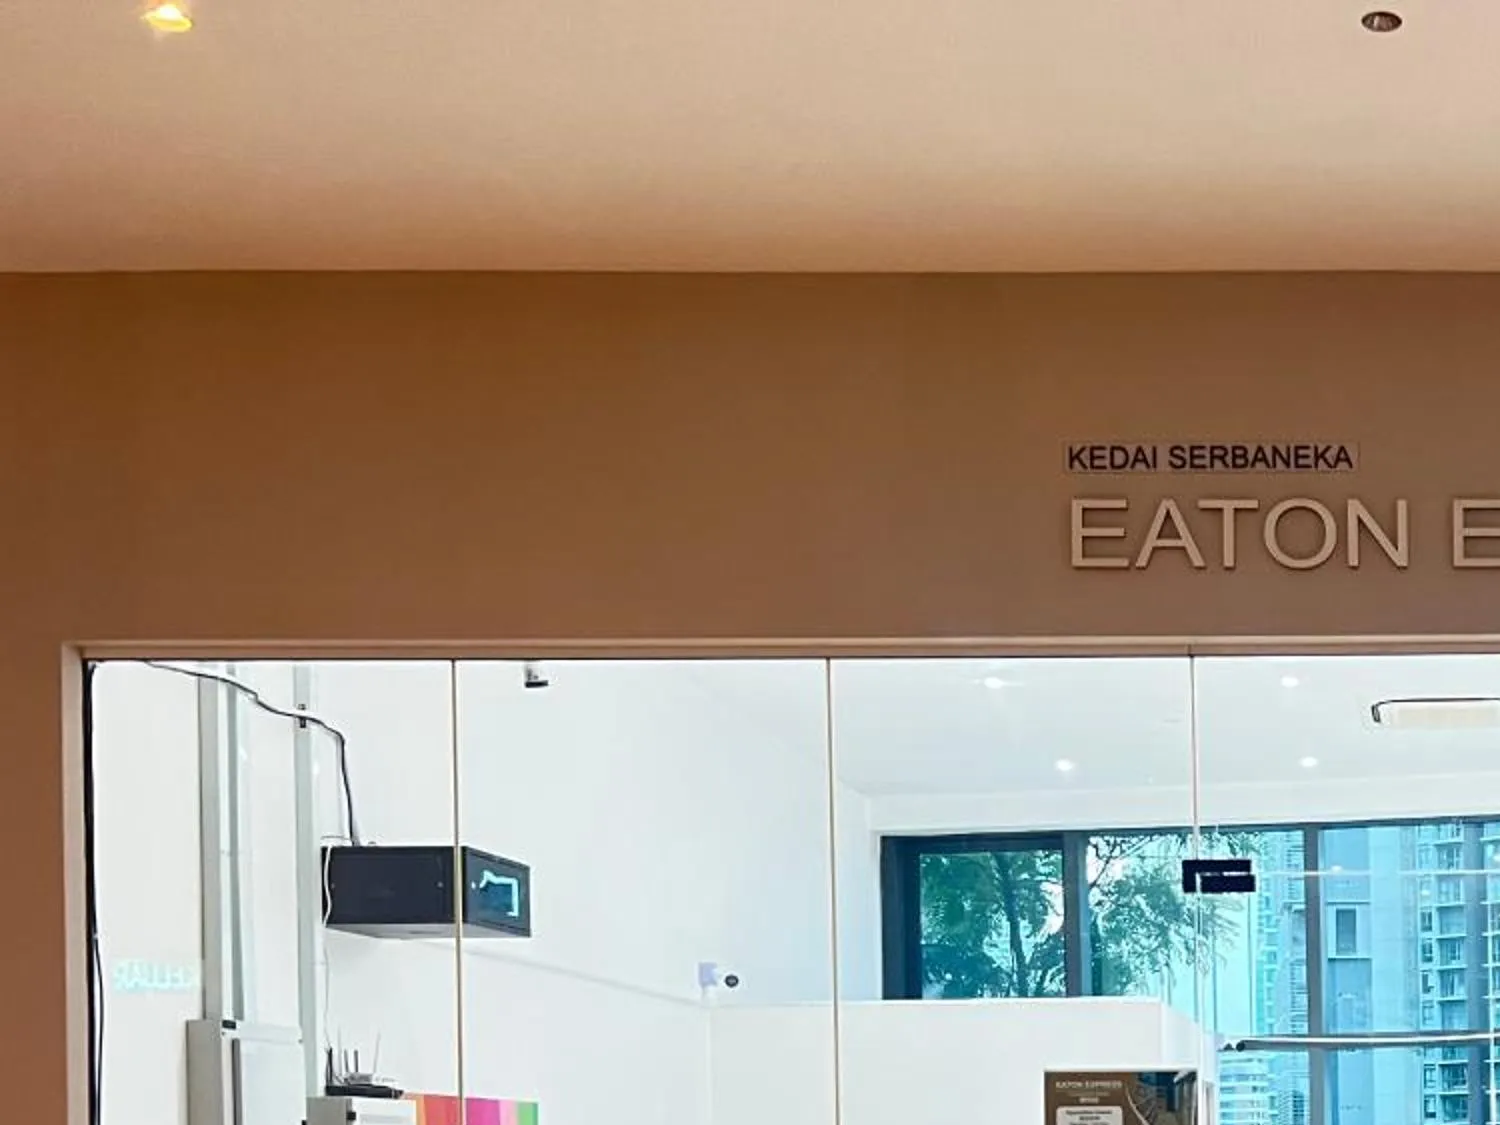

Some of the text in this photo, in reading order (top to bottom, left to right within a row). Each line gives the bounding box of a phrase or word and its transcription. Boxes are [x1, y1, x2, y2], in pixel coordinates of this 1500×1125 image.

[1068, 445, 1353, 470] KEDAI SERBANEKA
[1070, 498, 1408, 570] EATON
